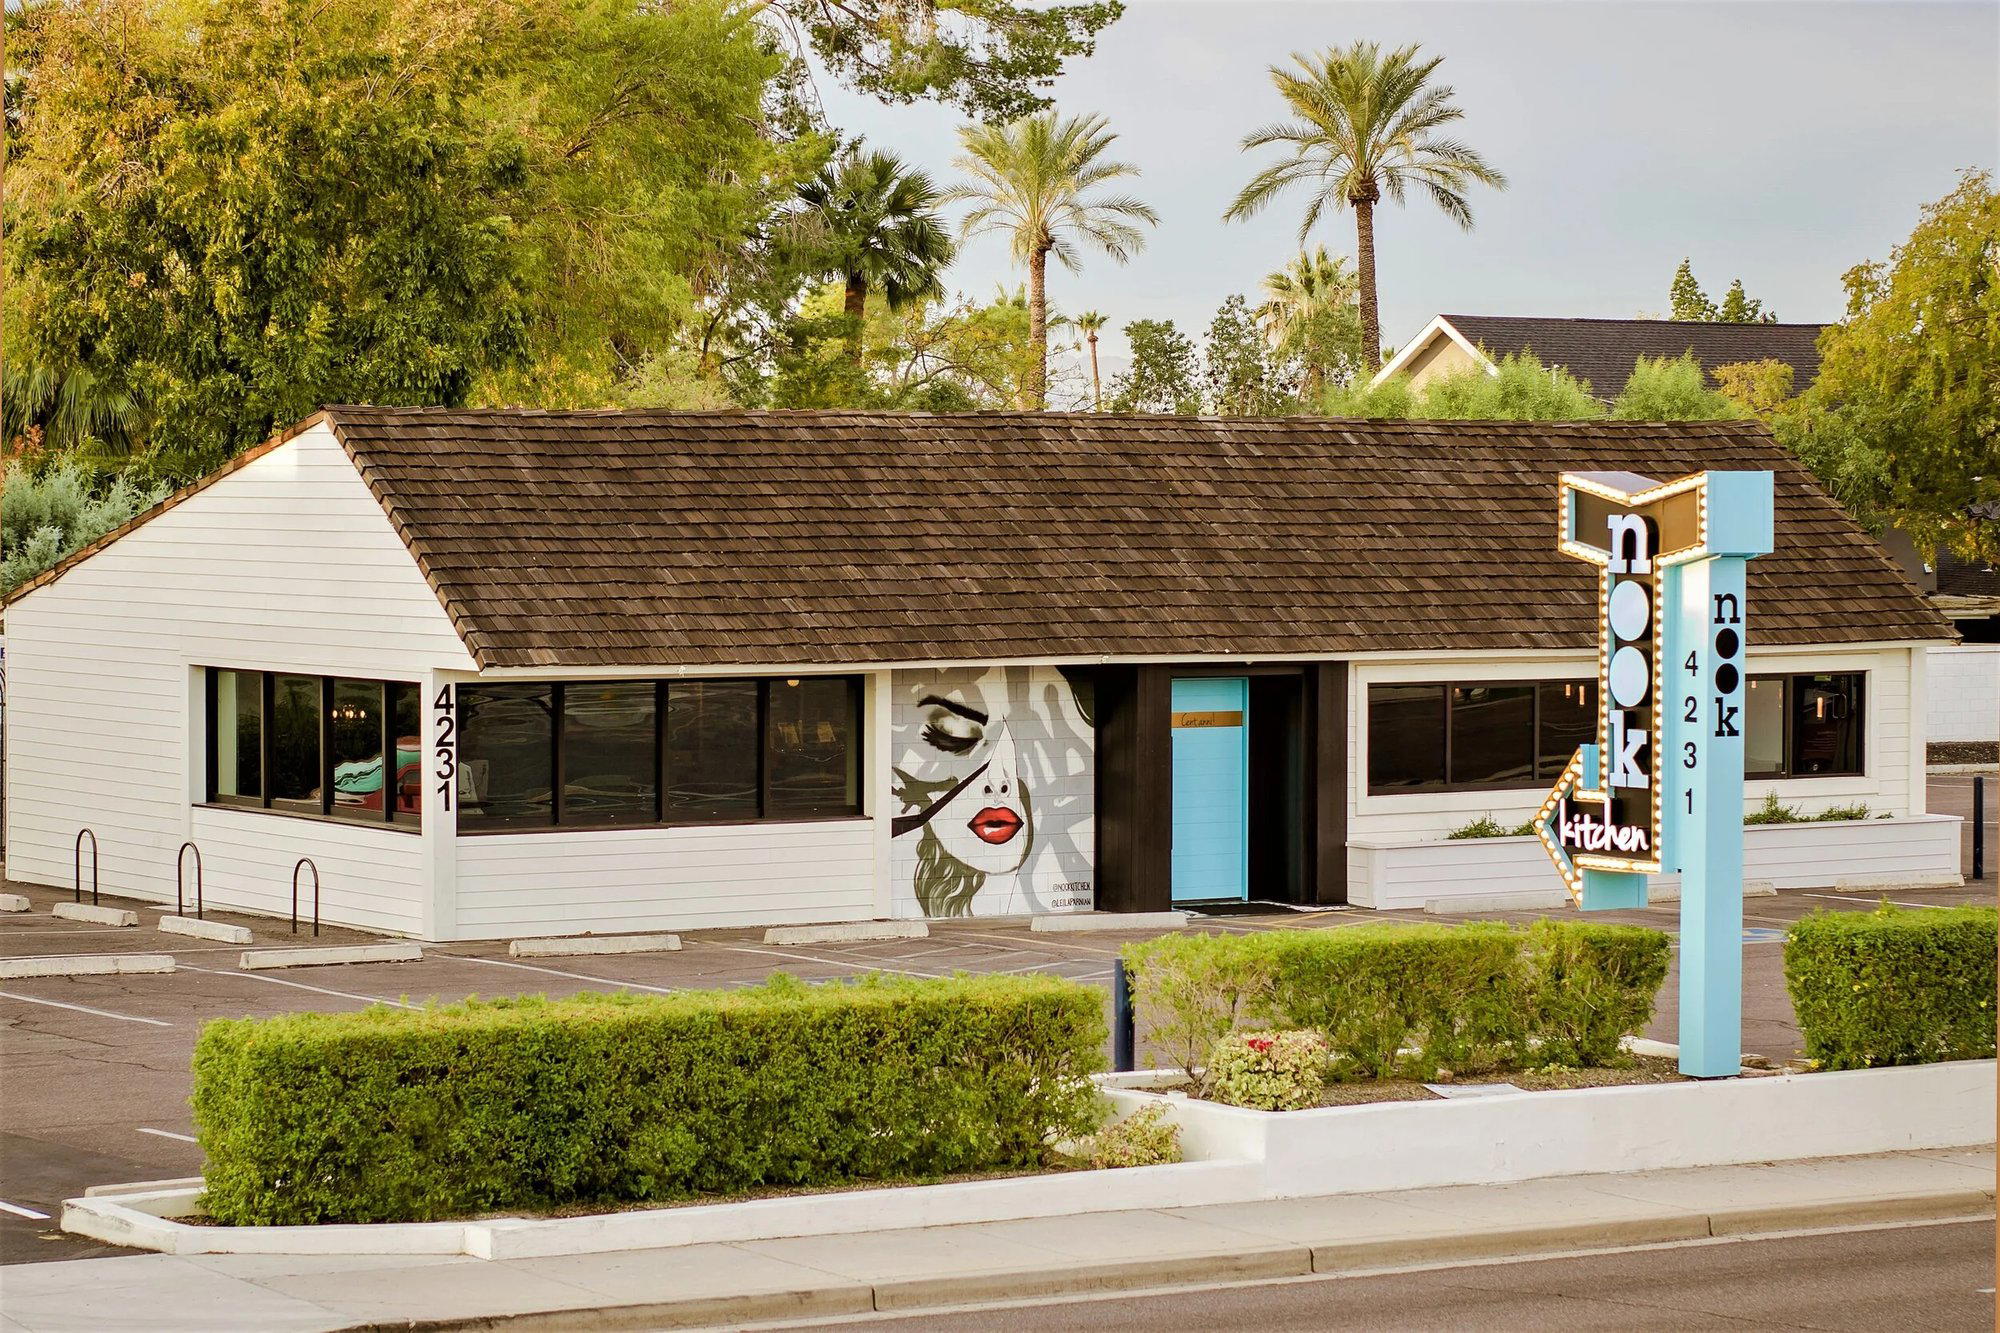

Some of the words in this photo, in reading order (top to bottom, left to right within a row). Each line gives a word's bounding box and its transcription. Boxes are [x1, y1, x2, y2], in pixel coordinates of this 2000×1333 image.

[1607, 514, 1651, 788] nook
[1714, 593, 1739, 737] nook
[434, 684, 454, 811] 4231
[1684, 650, 1698, 814] 4231
[1559, 798, 1650, 852] kitchen
